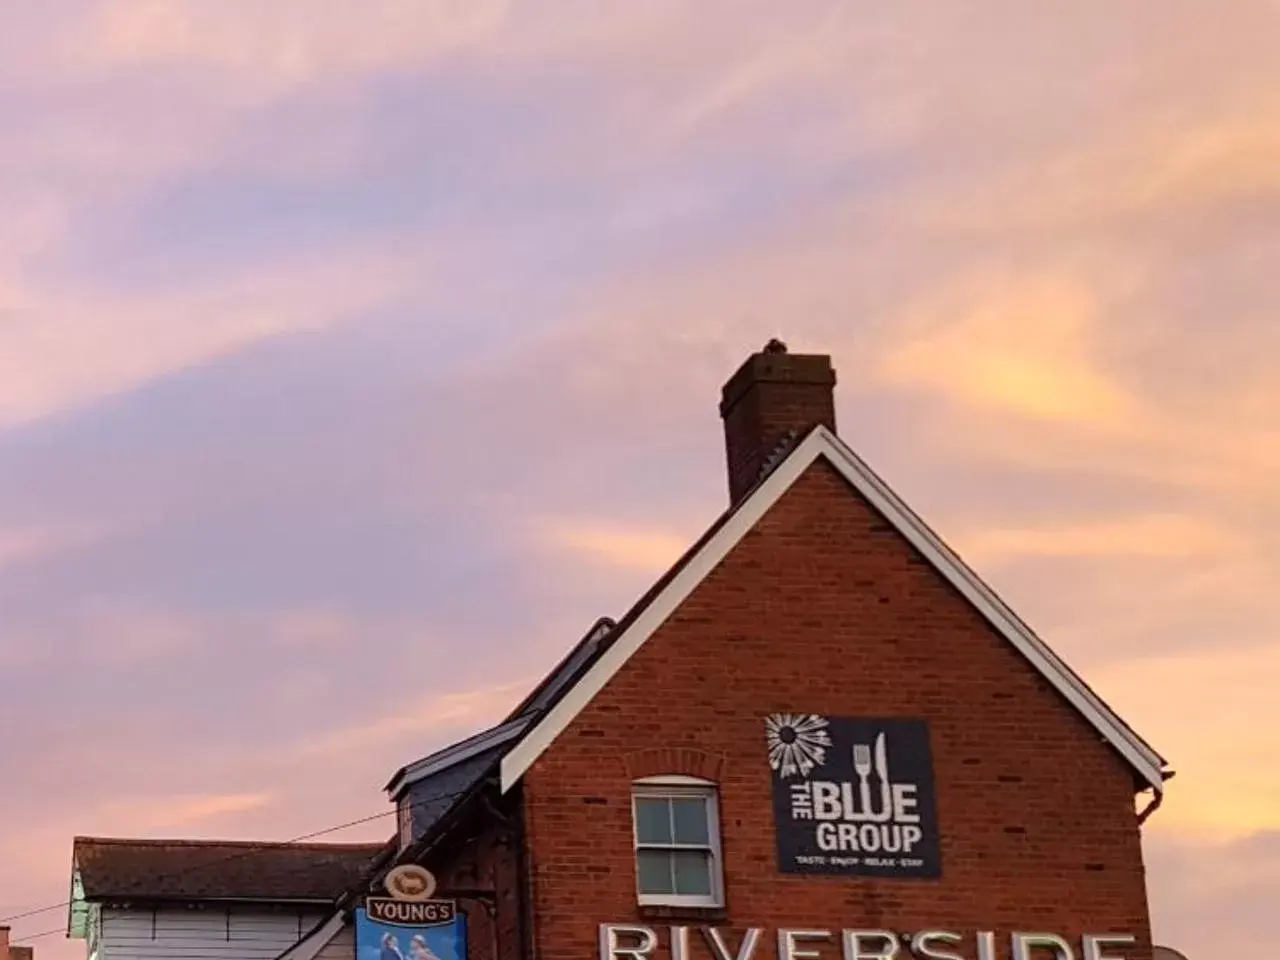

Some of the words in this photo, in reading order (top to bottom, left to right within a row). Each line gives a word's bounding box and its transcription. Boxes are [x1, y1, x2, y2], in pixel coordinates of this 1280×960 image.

[790, 781, 813, 820] THE
[811, 768, 921, 823] BLUE
[816, 822, 923, 853] GROUP
[373, 901, 450, 921] YOUNG'S
